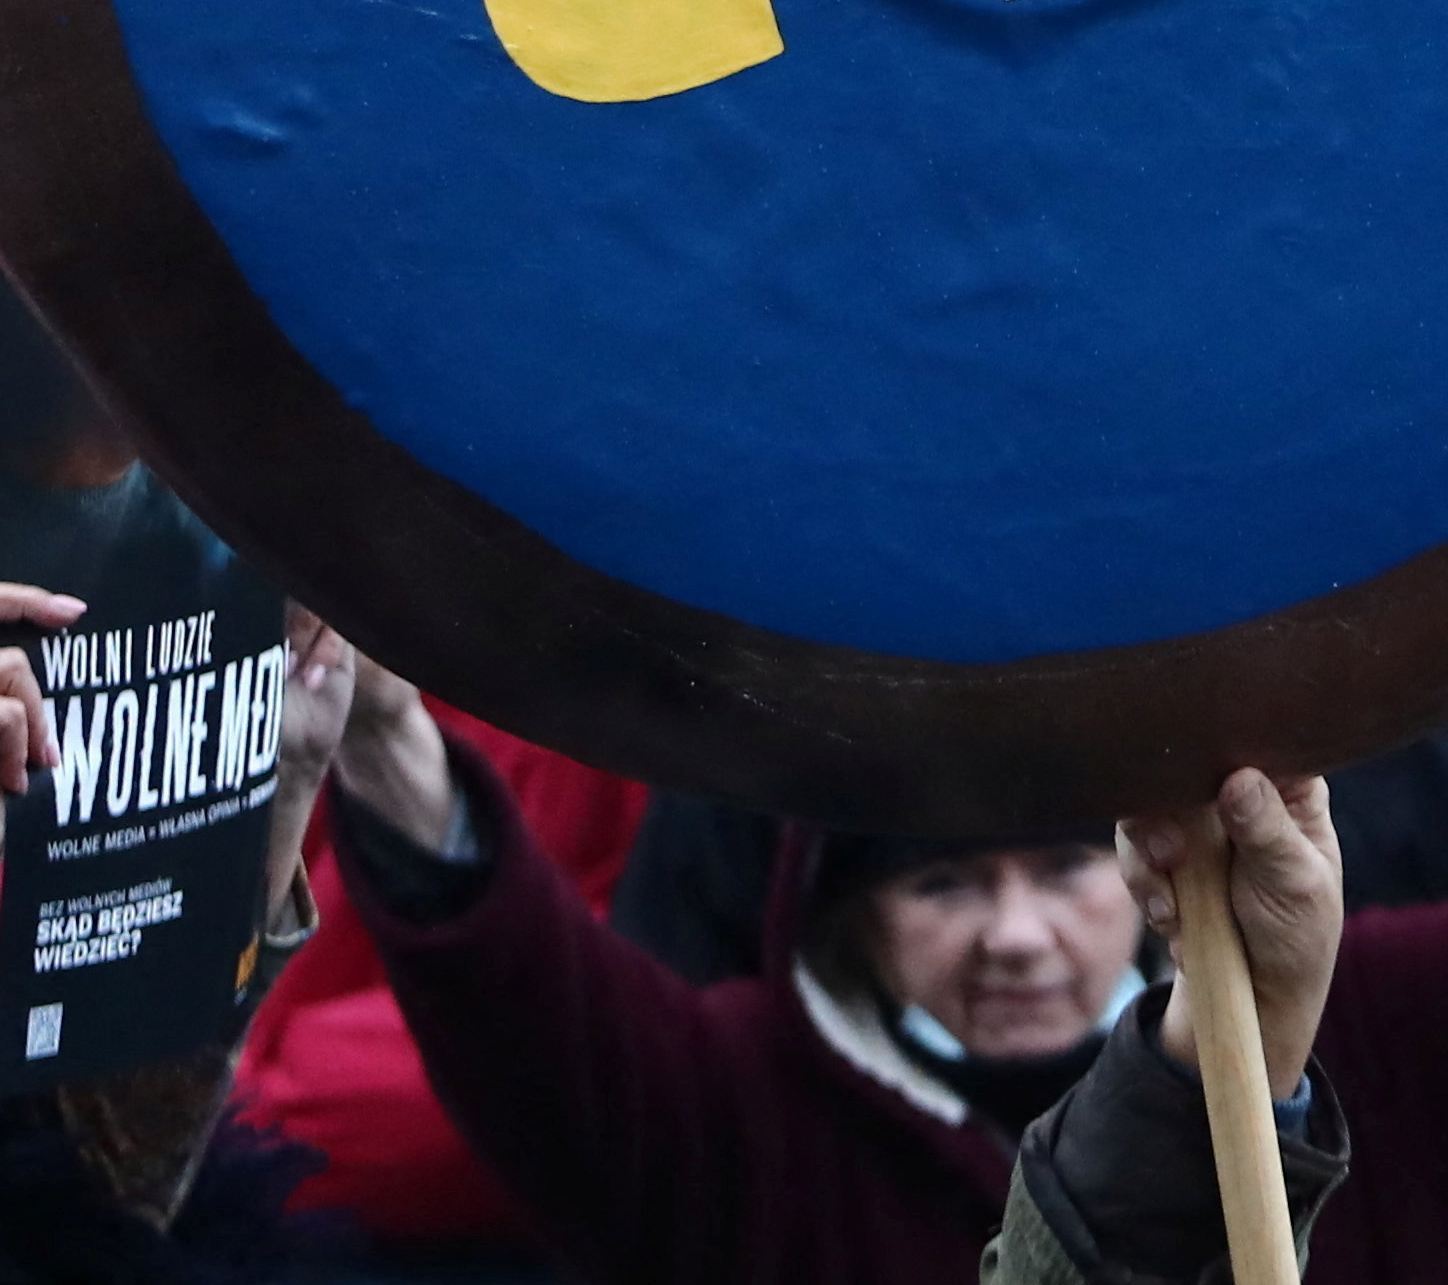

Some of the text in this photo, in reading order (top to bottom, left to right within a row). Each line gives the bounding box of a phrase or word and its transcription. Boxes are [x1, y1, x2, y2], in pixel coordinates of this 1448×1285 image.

[41, 609, 215, 691] WOLNI LUDZIE
[42, 671, 216, 827] WOLNE
[47, 833, 101, 862] WOLNE
[105, 825, 146, 851] MEDIA
[36, 890, 183, 945] SKĄD BĘDZIESZ
[34, 929, 142, 973] WIEDZIEĆ?
